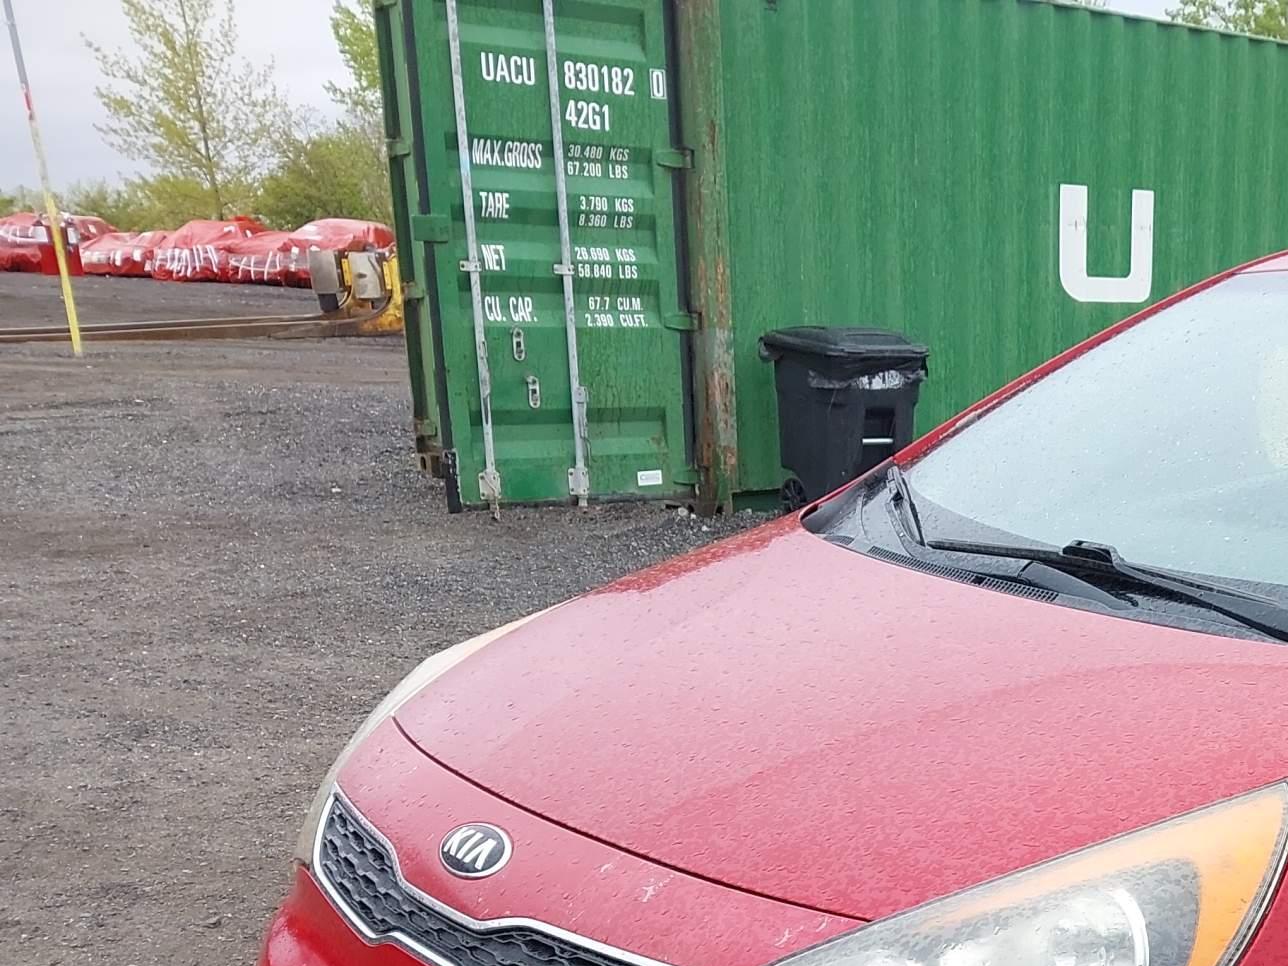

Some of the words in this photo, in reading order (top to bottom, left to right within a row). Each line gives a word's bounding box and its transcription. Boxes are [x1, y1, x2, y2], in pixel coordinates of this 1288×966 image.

[480, 52, 536, 86] UACU
[564, 60, 635, 96] 830182
[652, 70, 666, 98] 0
[565, 99, 610, 132] 42G1
[472, 138, 543, 169] MAX.GROSS
[567, 144, 603, 160] 30.480
[609, 147, 630, 161] KGS
[567, 161, 602, 178] 67.200
[608, 163, 629, 179] LBS
[479, 191, 510, 219] TARE
[580, 195, 608, 212] 3.790
[614, 197, 635, 213] KGS
[578, 212, 608, 228] 8.360
[613, 214, 634, 229] LBS
[481, 244, 507, 271] NET
[614, 248, 637, 262] KGS
[578, 263, 612, 279] 58.840
[618, 264, 638, 279] LBS
[484, 296, 507, 323] CU.
[509, 296, 538, 323] CAP.
[588, 296, 610, 311] 67.7
